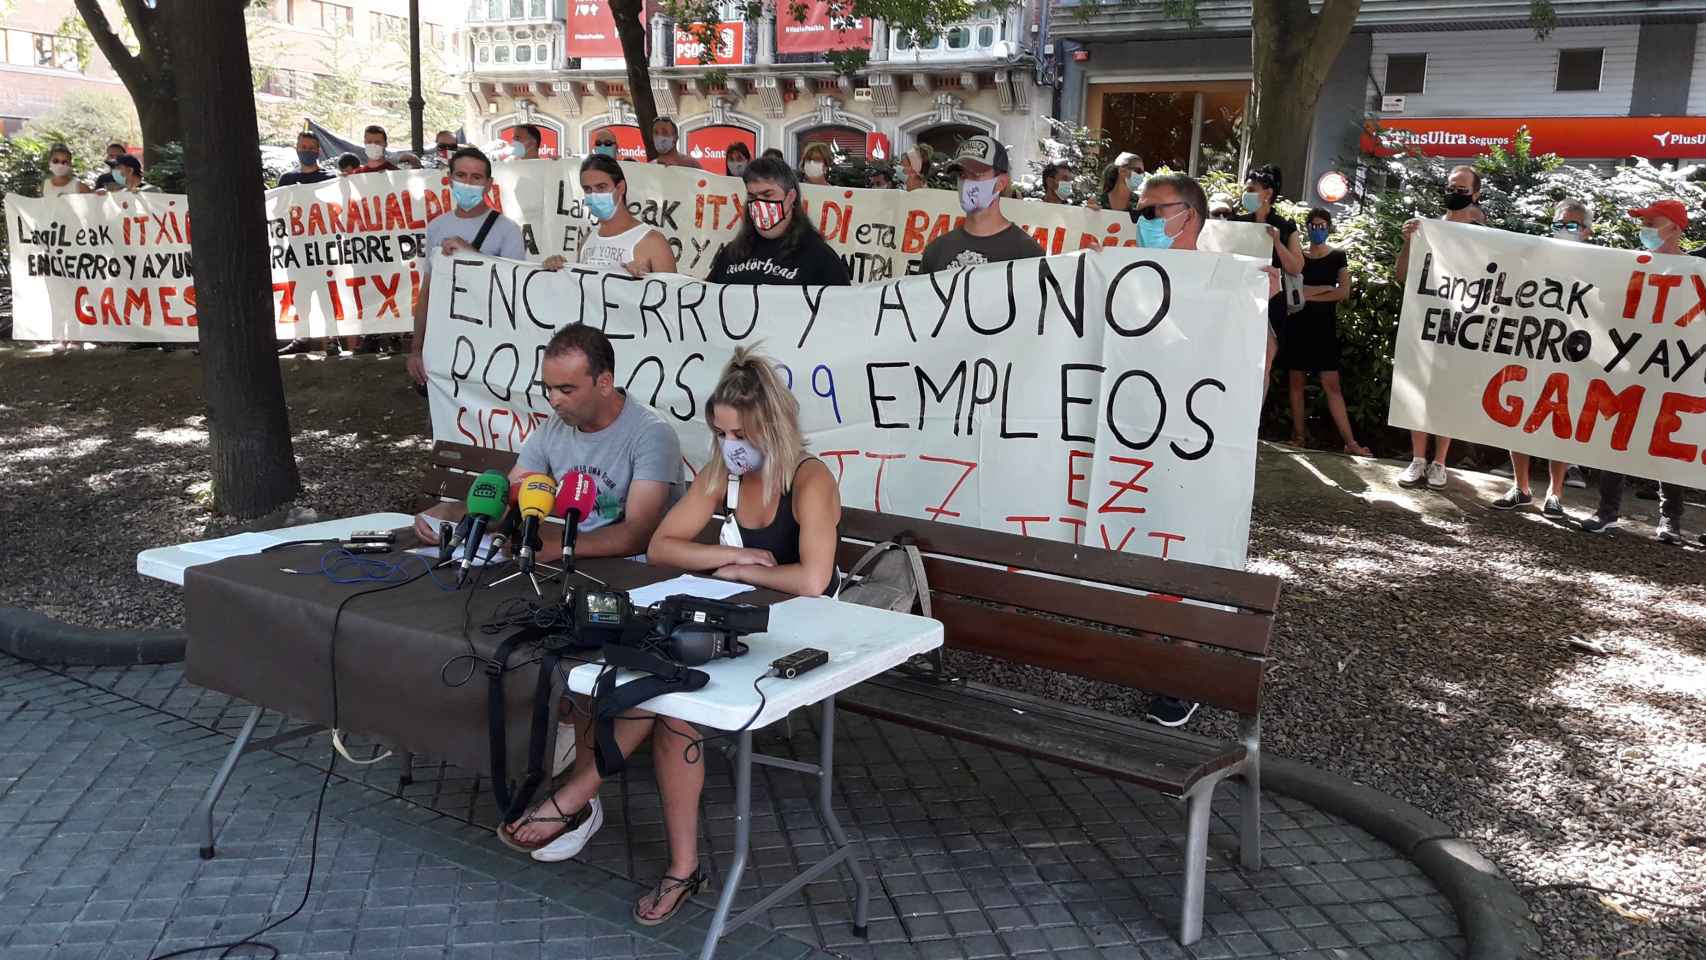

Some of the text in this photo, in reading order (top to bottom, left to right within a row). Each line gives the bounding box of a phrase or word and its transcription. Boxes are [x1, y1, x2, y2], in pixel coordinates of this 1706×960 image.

[704, 146, 727, 159] Sant
[1469, 135, 1509, 146] Seguros
[124, 255, 137, 280] Y
[272, 244, 300, 270] RA
[304, 240, 324, 266] EL
[397, 233, 426, 260] DE
[75, 286, 199, 327] GAMES
[272, 281, 299, 323] Z
[450, 253, 1171, 349] ENCIERRO Y AYUNO
[1603, 328, 1642, 373] Y
[1638, 339, 1706, 384] AY
[624, 353, 705, 422] OS
[866, 358, 1227, 461] EMPLEOS
[1482, 364, 1706, 466] GAME
[1068, 450, 1153, 513] EZ
